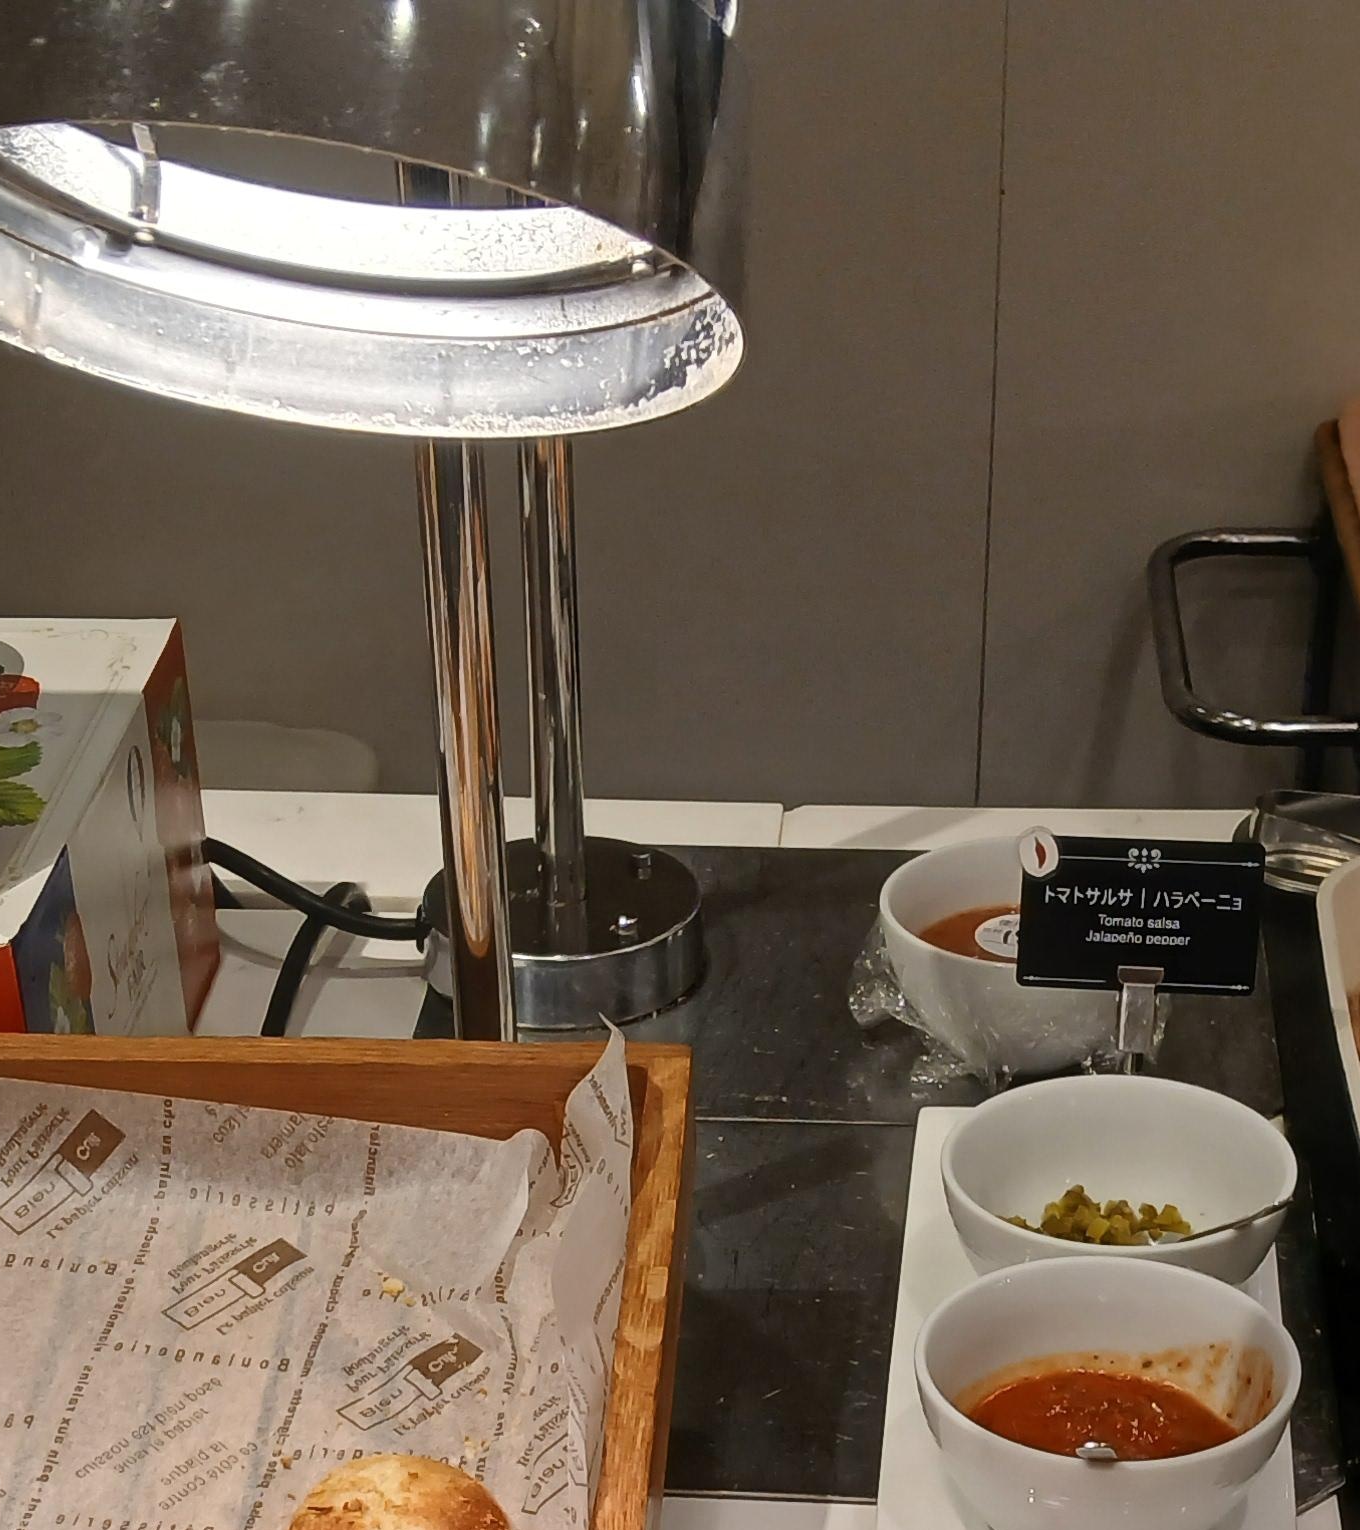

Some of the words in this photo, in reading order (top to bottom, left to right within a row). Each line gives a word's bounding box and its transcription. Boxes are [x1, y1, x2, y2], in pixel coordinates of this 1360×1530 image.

[1044, 884, 1134, 907] トマトサルサ
[1098, 913, 1145, 928] Tomato
[1147, 917, 1181, 930] salsa
[1085, 930, 1143, 944] Jalapeño
[1146, 932, 1191, 946] pepper
